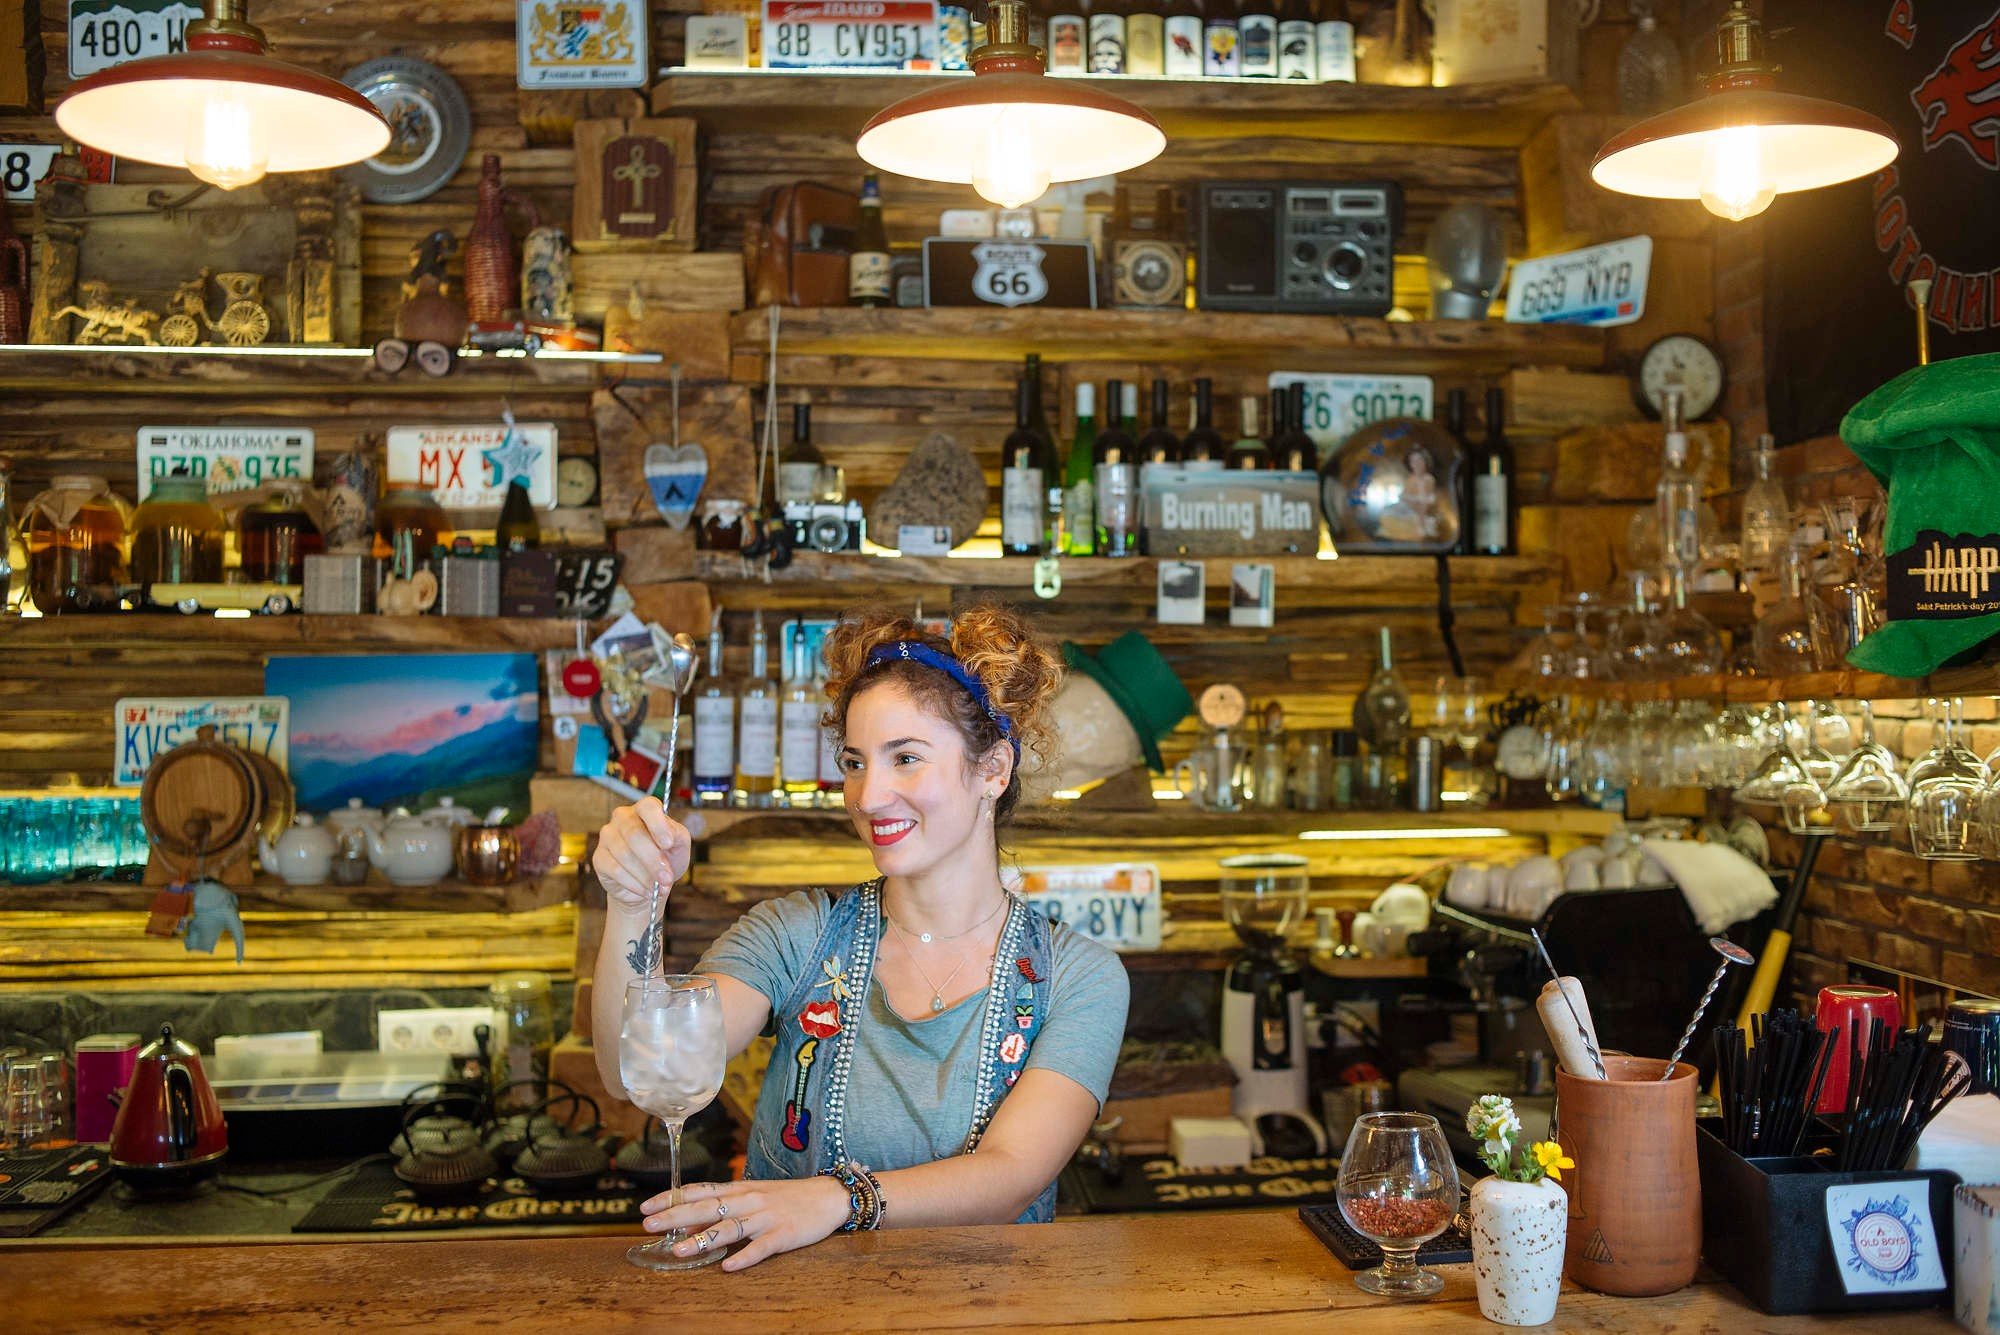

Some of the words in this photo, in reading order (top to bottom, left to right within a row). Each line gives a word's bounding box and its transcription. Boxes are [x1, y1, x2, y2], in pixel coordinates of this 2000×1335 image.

[777, 23, 810, 57] 8B
[990, 271, 1030, 296] 66
[1520, 275, 1567, 317] 669
[423, 432, 505, 445] ARKANSA
[420, 449, 464, 489] MX
[1161, 492, 1256, 541] Burning
[1261, 492, 1313, 531] Man
[214, 721, 279, 757] 517
[1089, 897, 1145, 937] 8VY
